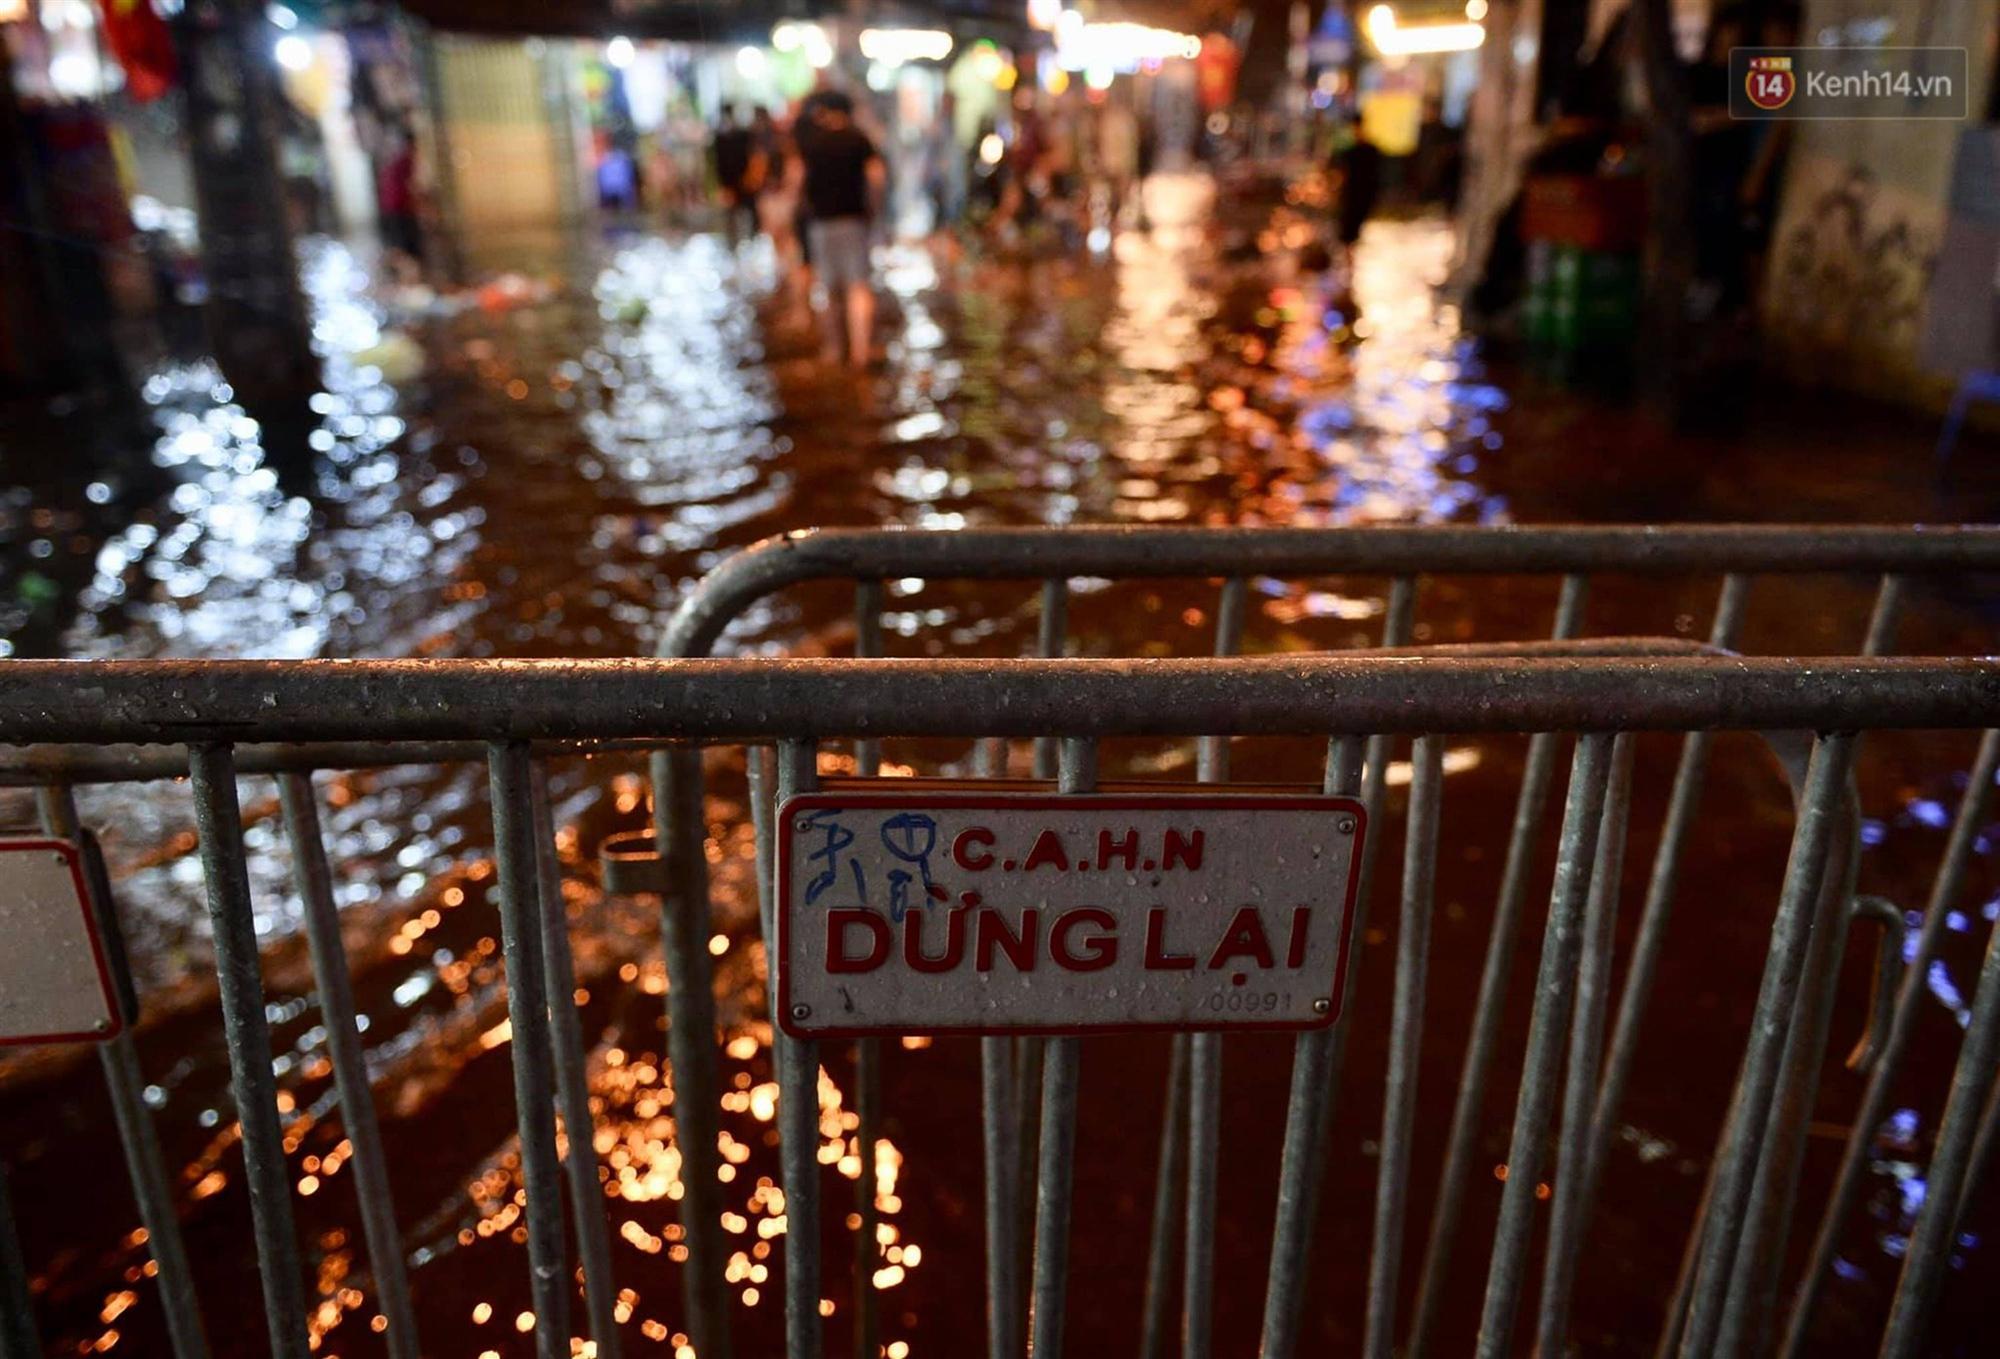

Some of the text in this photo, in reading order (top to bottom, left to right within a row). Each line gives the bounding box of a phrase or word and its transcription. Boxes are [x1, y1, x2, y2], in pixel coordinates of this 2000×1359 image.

[952, 827, 1205, 872] C.A.H.N
[825, 882, 1311, 986] DỪNG LẠI
